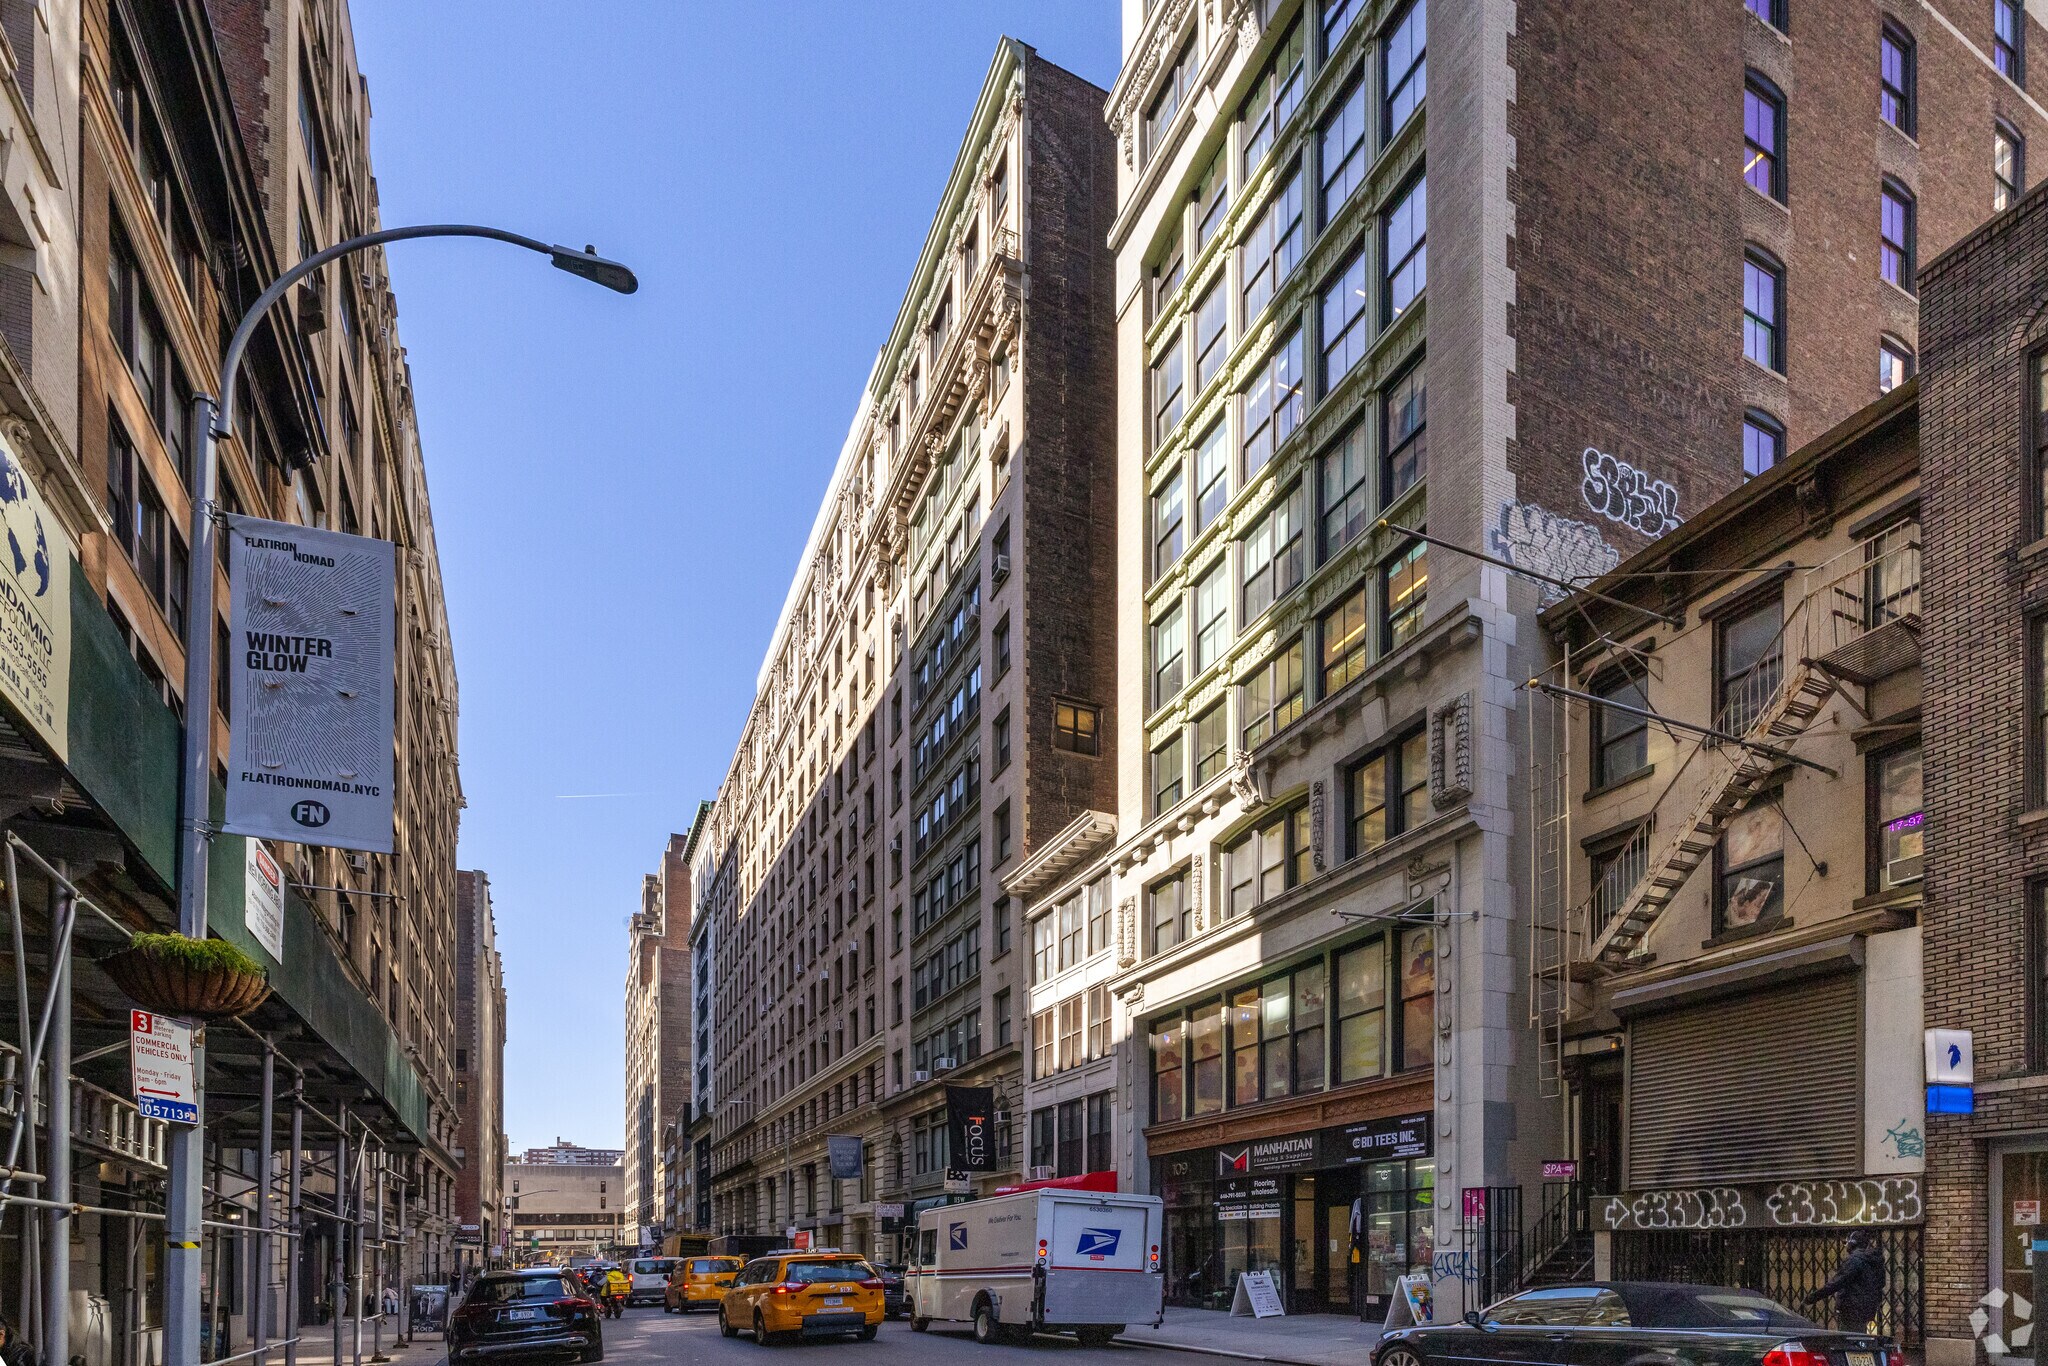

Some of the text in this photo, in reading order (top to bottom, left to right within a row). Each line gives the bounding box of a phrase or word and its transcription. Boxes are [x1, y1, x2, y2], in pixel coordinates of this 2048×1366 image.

[244, 537, 297, 552] FLATIRON
[294, 551, 335, 568] NOMAD
[246, 631, 333, 659] WINTER
[246, 651, 309, 674] GLOW
[241, 772, 380, 797] FLATIRONNOMAD.NYC
[296, 804, 325, 824] FN
[137, 1014, 148, 1031] 3
[135, 1036, 181, 1052] COMMERCIAL
[136, 1045, 188, 1062] VEHICLES ONLY
[136, 1067, 160, 1077] Monday
[164, 1071, 182, 1081] Friday
[137, 1075, 150, 1083] 8am
[154, 1078, 168, 1086] 6pm
[140, 1103, 184, 1120] 105713
[1253, 1137, 1313, 1157] MANHATTAN
[1361, 1136, 1373, 1148] BD
[1374, 1132, 1398, 1146] TEES
[1399, 1130, 1417, 1143] INC.
[1285, 1151, 1313, 1160] Supplies
[1172, 1162, 1188, 1176] 109
[1544, 1163, 1562, 1174] SPA
[1250, 1187, 1279, 1197] wholesale
[1253, 1179, 1276, 1188] Flooring
